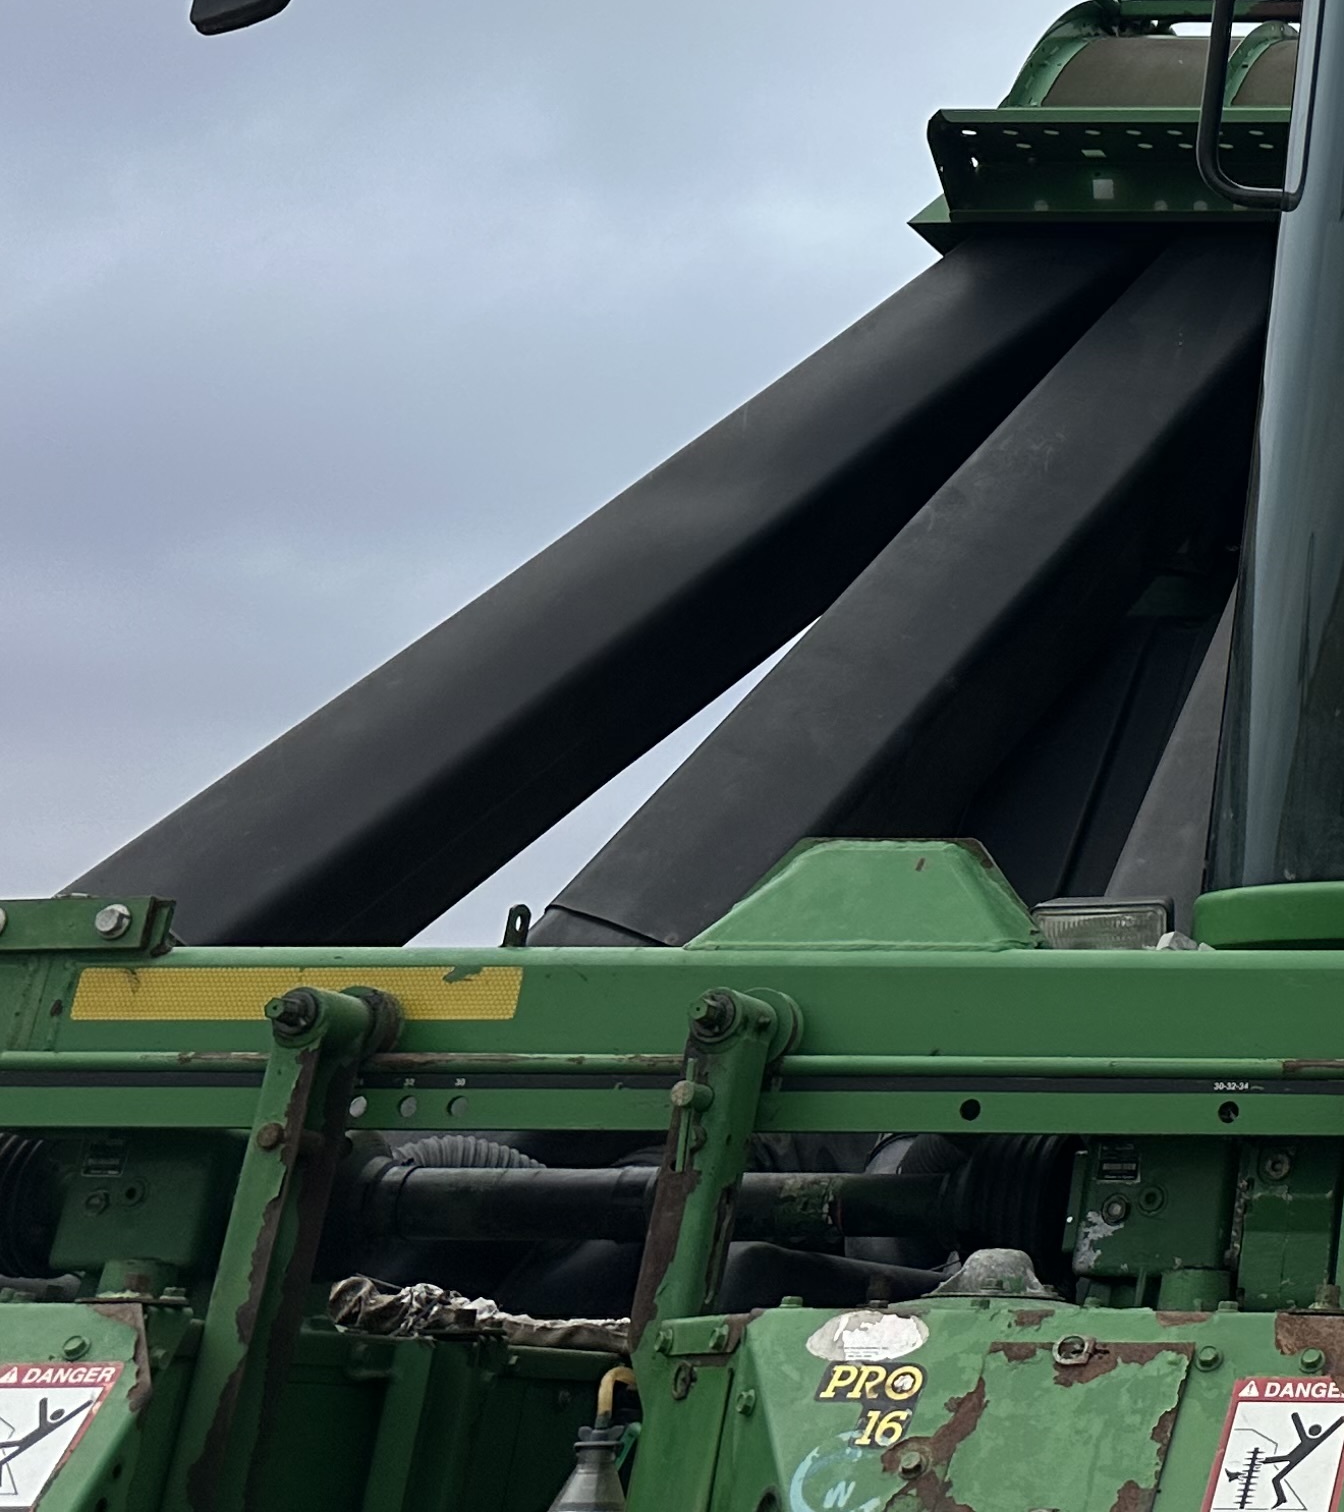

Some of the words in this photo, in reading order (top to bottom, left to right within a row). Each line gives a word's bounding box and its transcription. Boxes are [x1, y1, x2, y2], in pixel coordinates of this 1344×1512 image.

[21, 1366, 116, 1384] DANGER
[819, 1365, 923, 1401] PRO
[1264, 1382, 1344, 1398] DANGE
[854, 1410, 908, 1447] 16
